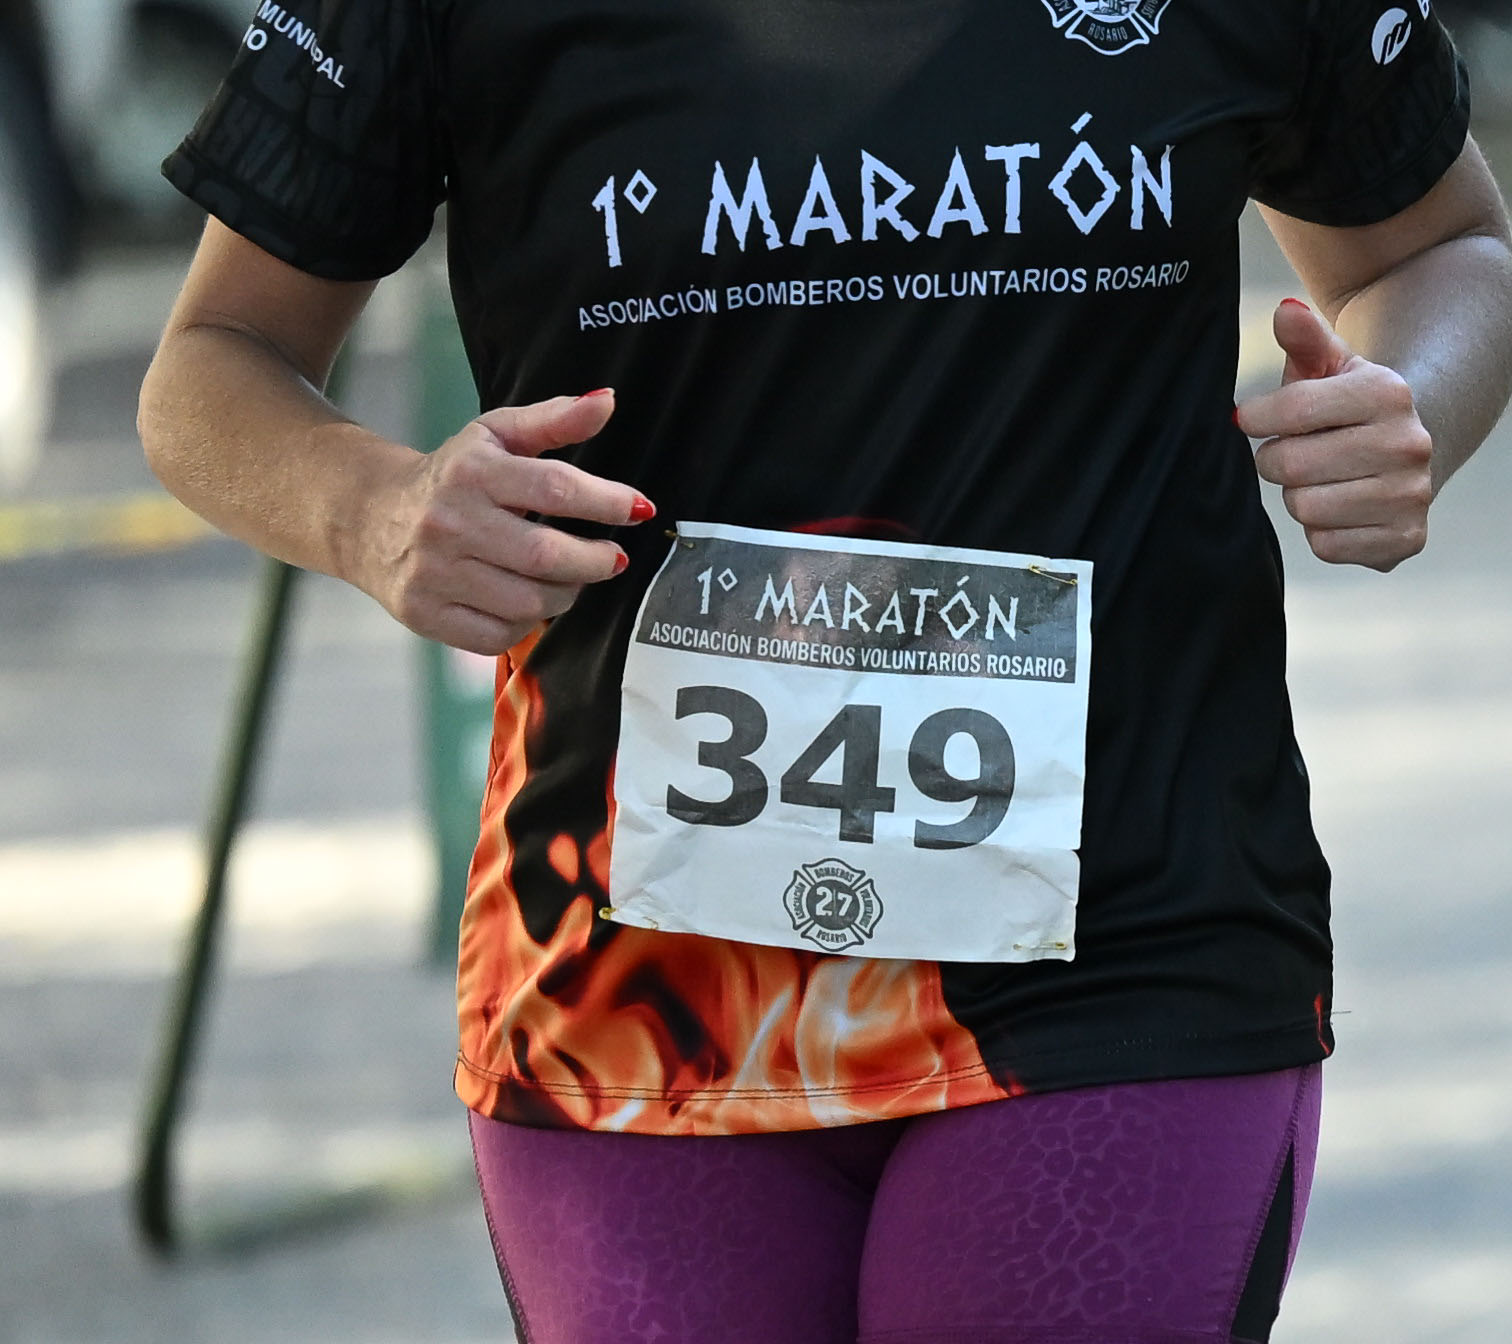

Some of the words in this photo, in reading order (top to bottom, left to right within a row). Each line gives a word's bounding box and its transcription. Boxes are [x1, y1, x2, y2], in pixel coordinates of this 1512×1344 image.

[1086, 22, 1129, 42] ROSARIO
[701, 111, 1175, 256] MARATÓN
[578, 284, 718, 332] ASOCIACIÓN
[726, 275, 884, 310] BOMBEROS
[893, 267, 1088, 301] VOLUNTARIOS
[1095, 260, 1190, 293] ROSARIO
[754, 575, 1020, 642] MARATÓN
[649, 621, 752, 655] ASOCIACIÓN
[757, 636, 855, 667] BOMBEROS
[861, 647, 981, 675] VOLUNTARIOS
[987, 656, 1068, 679] ROSARIO
[666, 685, 1016, 850] 349
[815, 886, 853, 916] 27
